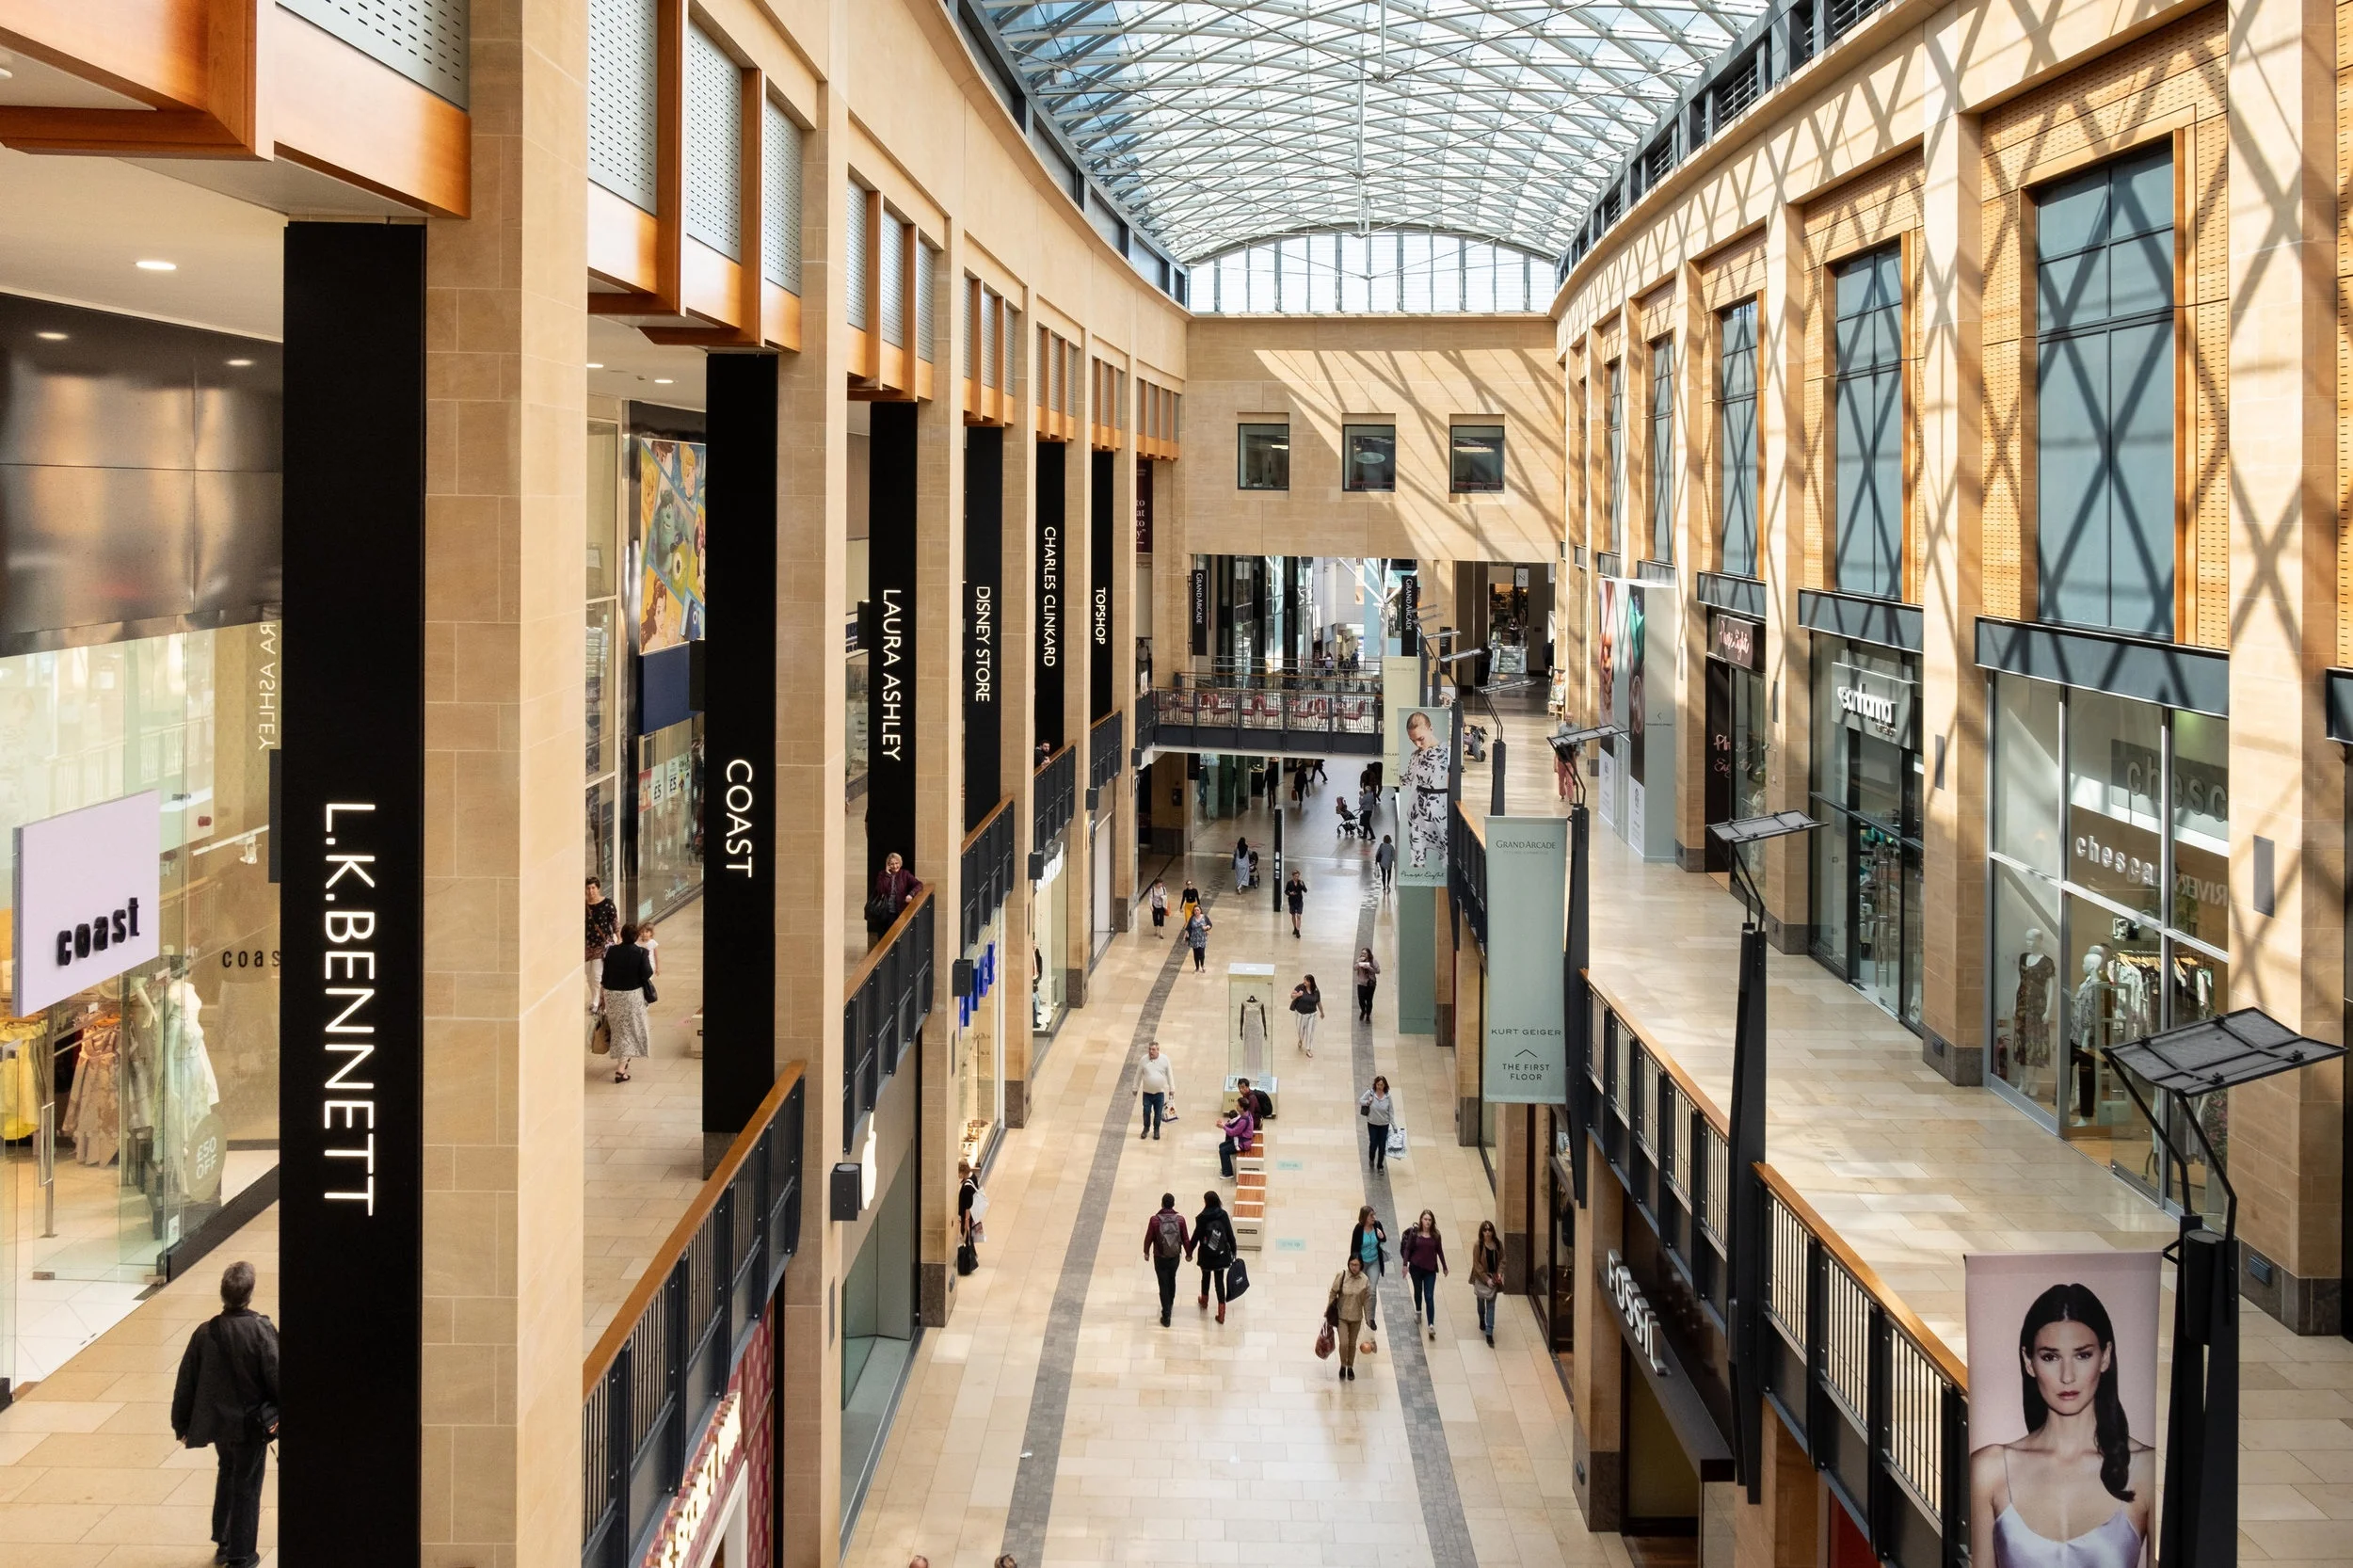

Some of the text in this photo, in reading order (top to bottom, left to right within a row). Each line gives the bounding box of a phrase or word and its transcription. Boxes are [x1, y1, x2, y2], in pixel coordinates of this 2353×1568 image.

[1044, 527, 1056, 667] CHARLES CLINKARD
[1096, 587, 1106, 645] TOPSHOP
[1195, 572, 1204, 599] GRAND
[882, 589, 901, 761] LAURA ASHLEY
[975, 586, 990, 702] DISNEY STORE
[726, 759, 752, 878] COAST
[1496, 840, 1557, 849] GRAND ARCADE
[2075, 835, 2155, 886] chesca
[56, 897, 140, 966] coast
[324, 803, 376, 1217] L.K.BENNETT
[196, 1154, 217, 1179] OFF
[197, 1136, 216, 1162] £50
[1608, 1249, 1671, 1375] FOSSIL
